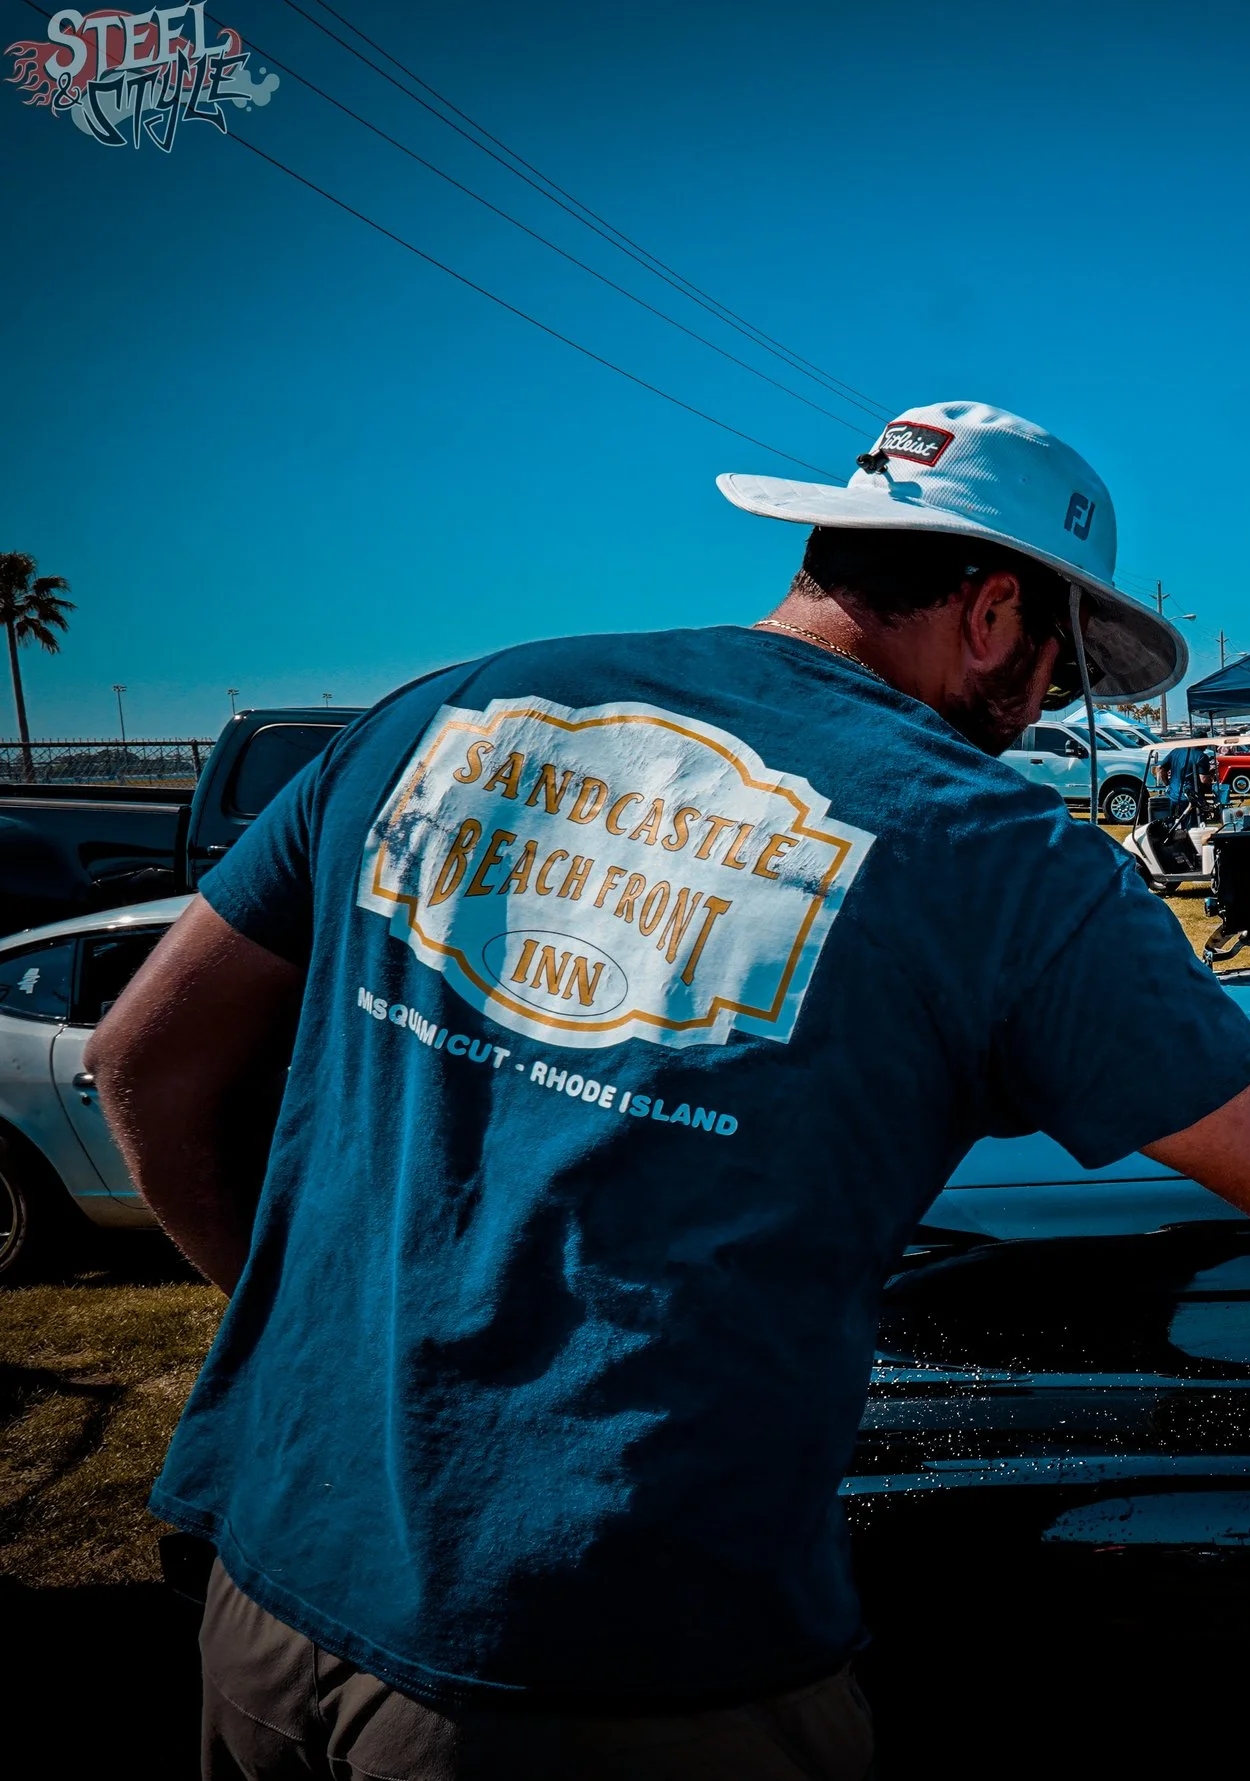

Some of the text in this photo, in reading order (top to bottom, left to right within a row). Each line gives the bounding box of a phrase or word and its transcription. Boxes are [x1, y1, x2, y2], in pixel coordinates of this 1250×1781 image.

[880, 426, 938, 456] Titleist
[452, 740, 800, 880] SANDCASTLE
[509, 938, 607, 1008] INN
[530, 1061, 617, 1110] RHODE
[618, 1090, 739, 1137] ISLAND
